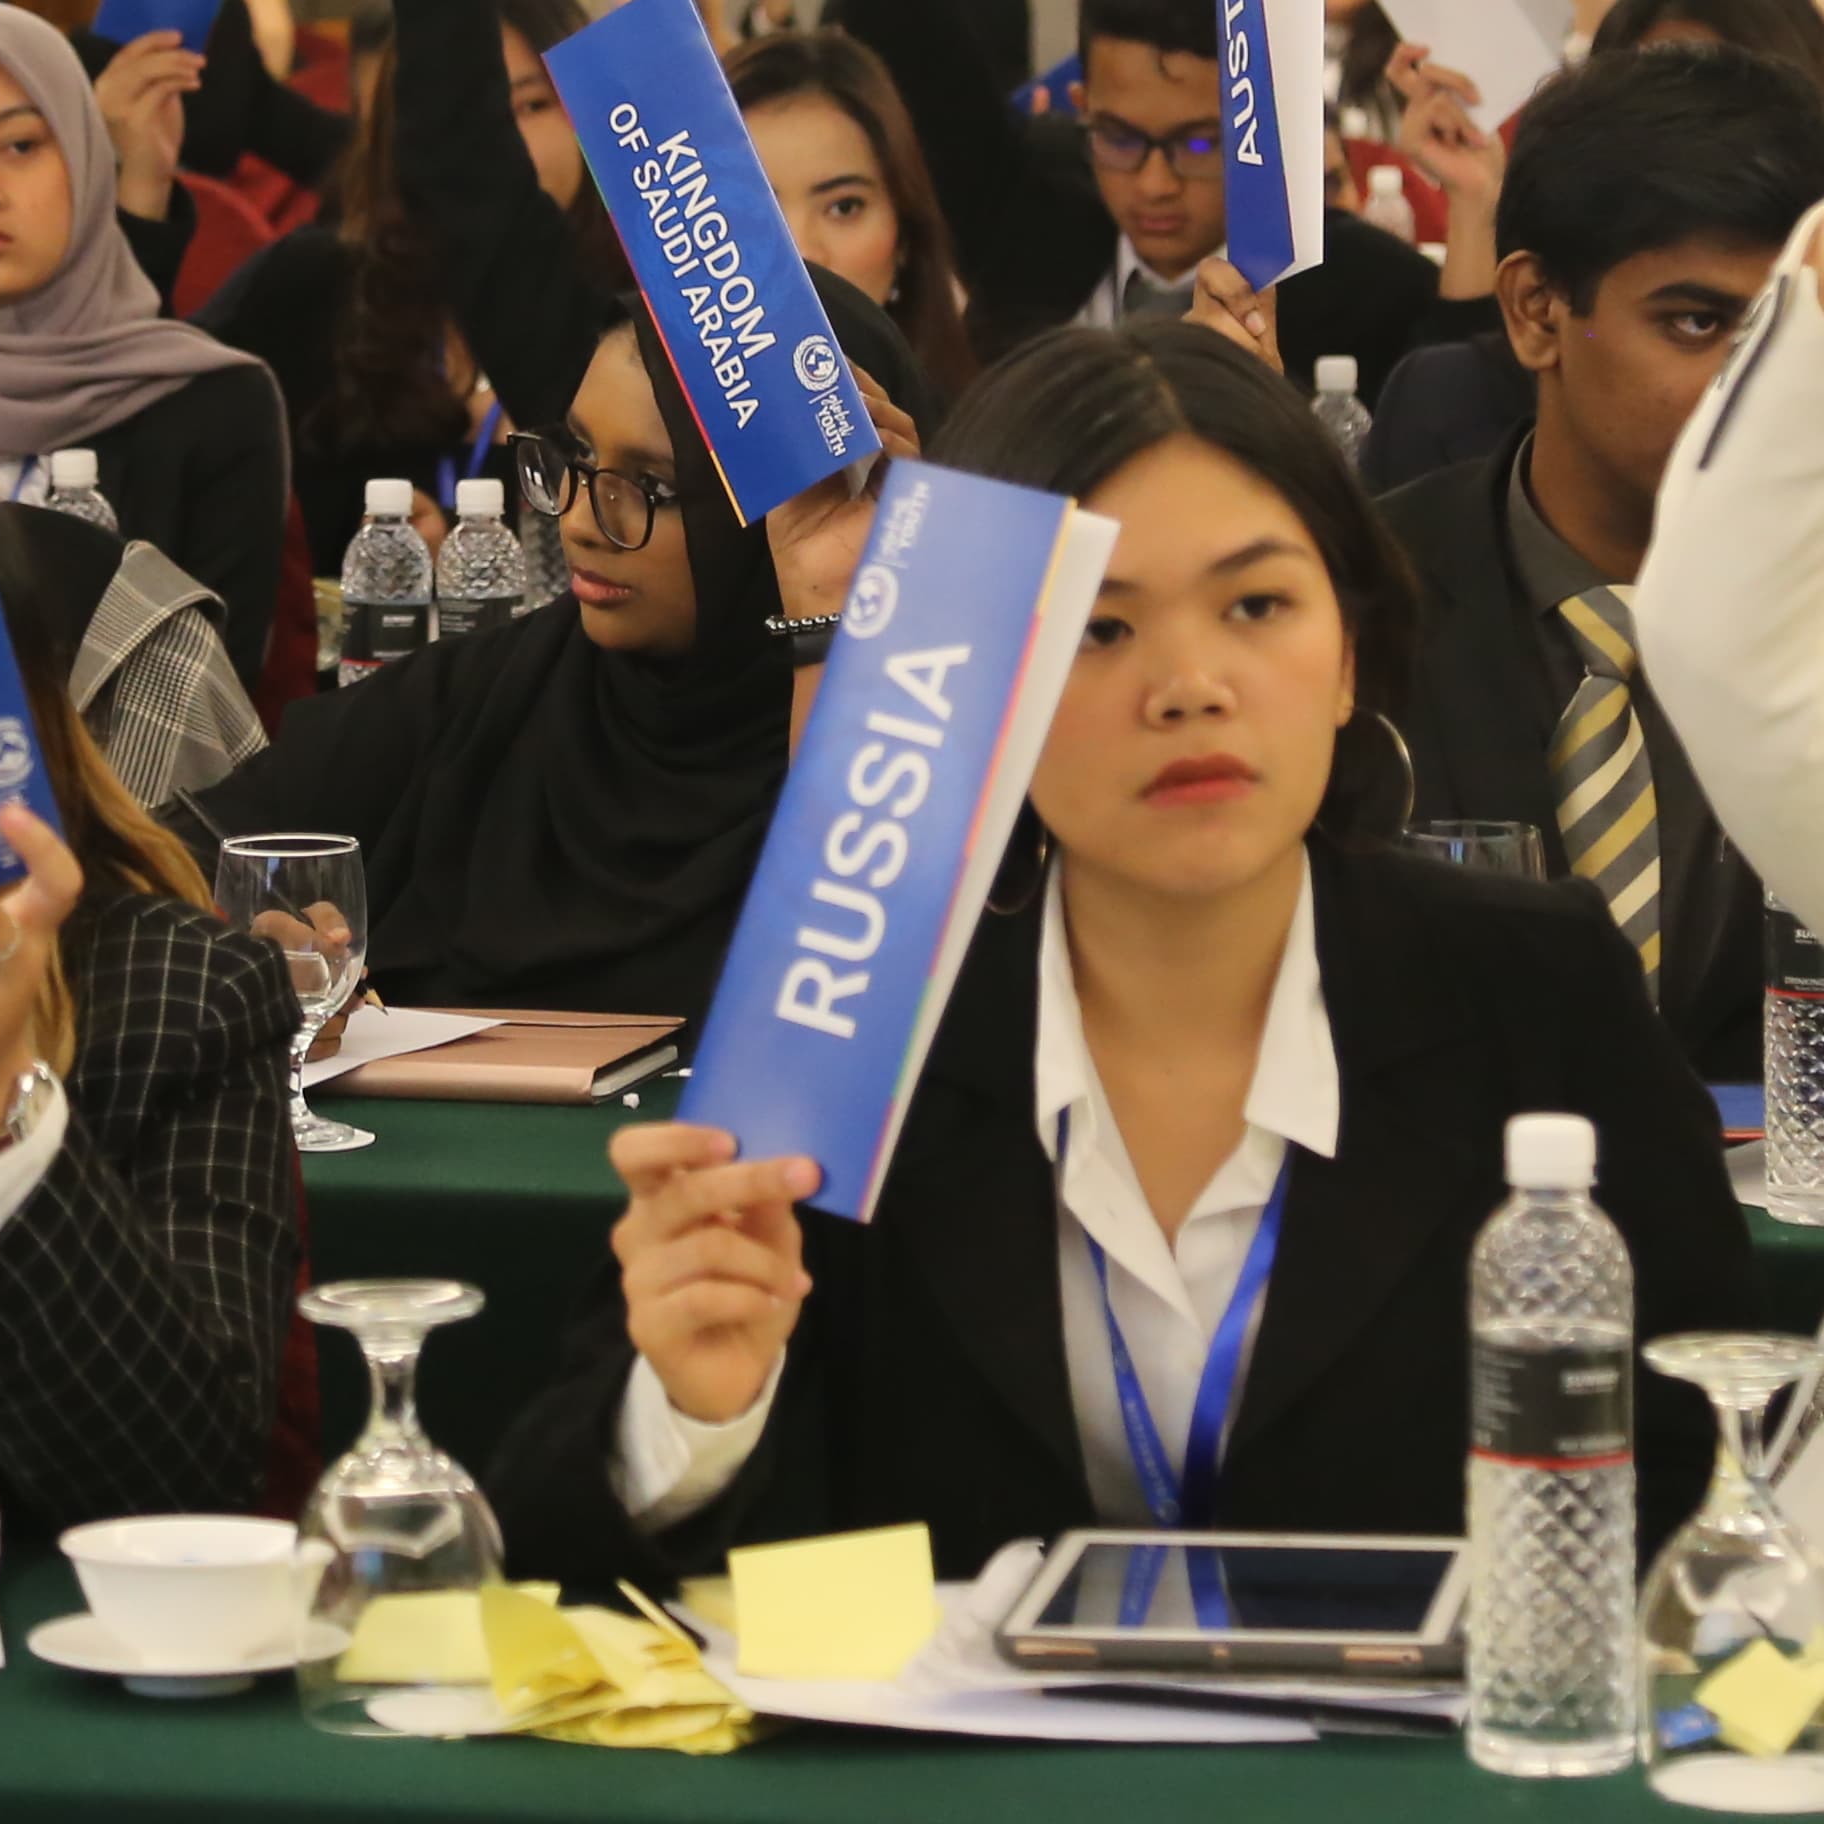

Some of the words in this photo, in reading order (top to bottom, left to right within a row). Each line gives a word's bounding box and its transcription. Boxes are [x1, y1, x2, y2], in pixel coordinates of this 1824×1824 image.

[609, 101, 651, 154] OF
[631, 160, 700, 279] SAUDI
[680, 285, 760, 431] ARABIA
[656, 129, 777, 360] KINGDOM
[818, 405, 847, 457] YOUTH
[775, 643, 973, 1039] RUSSIA
